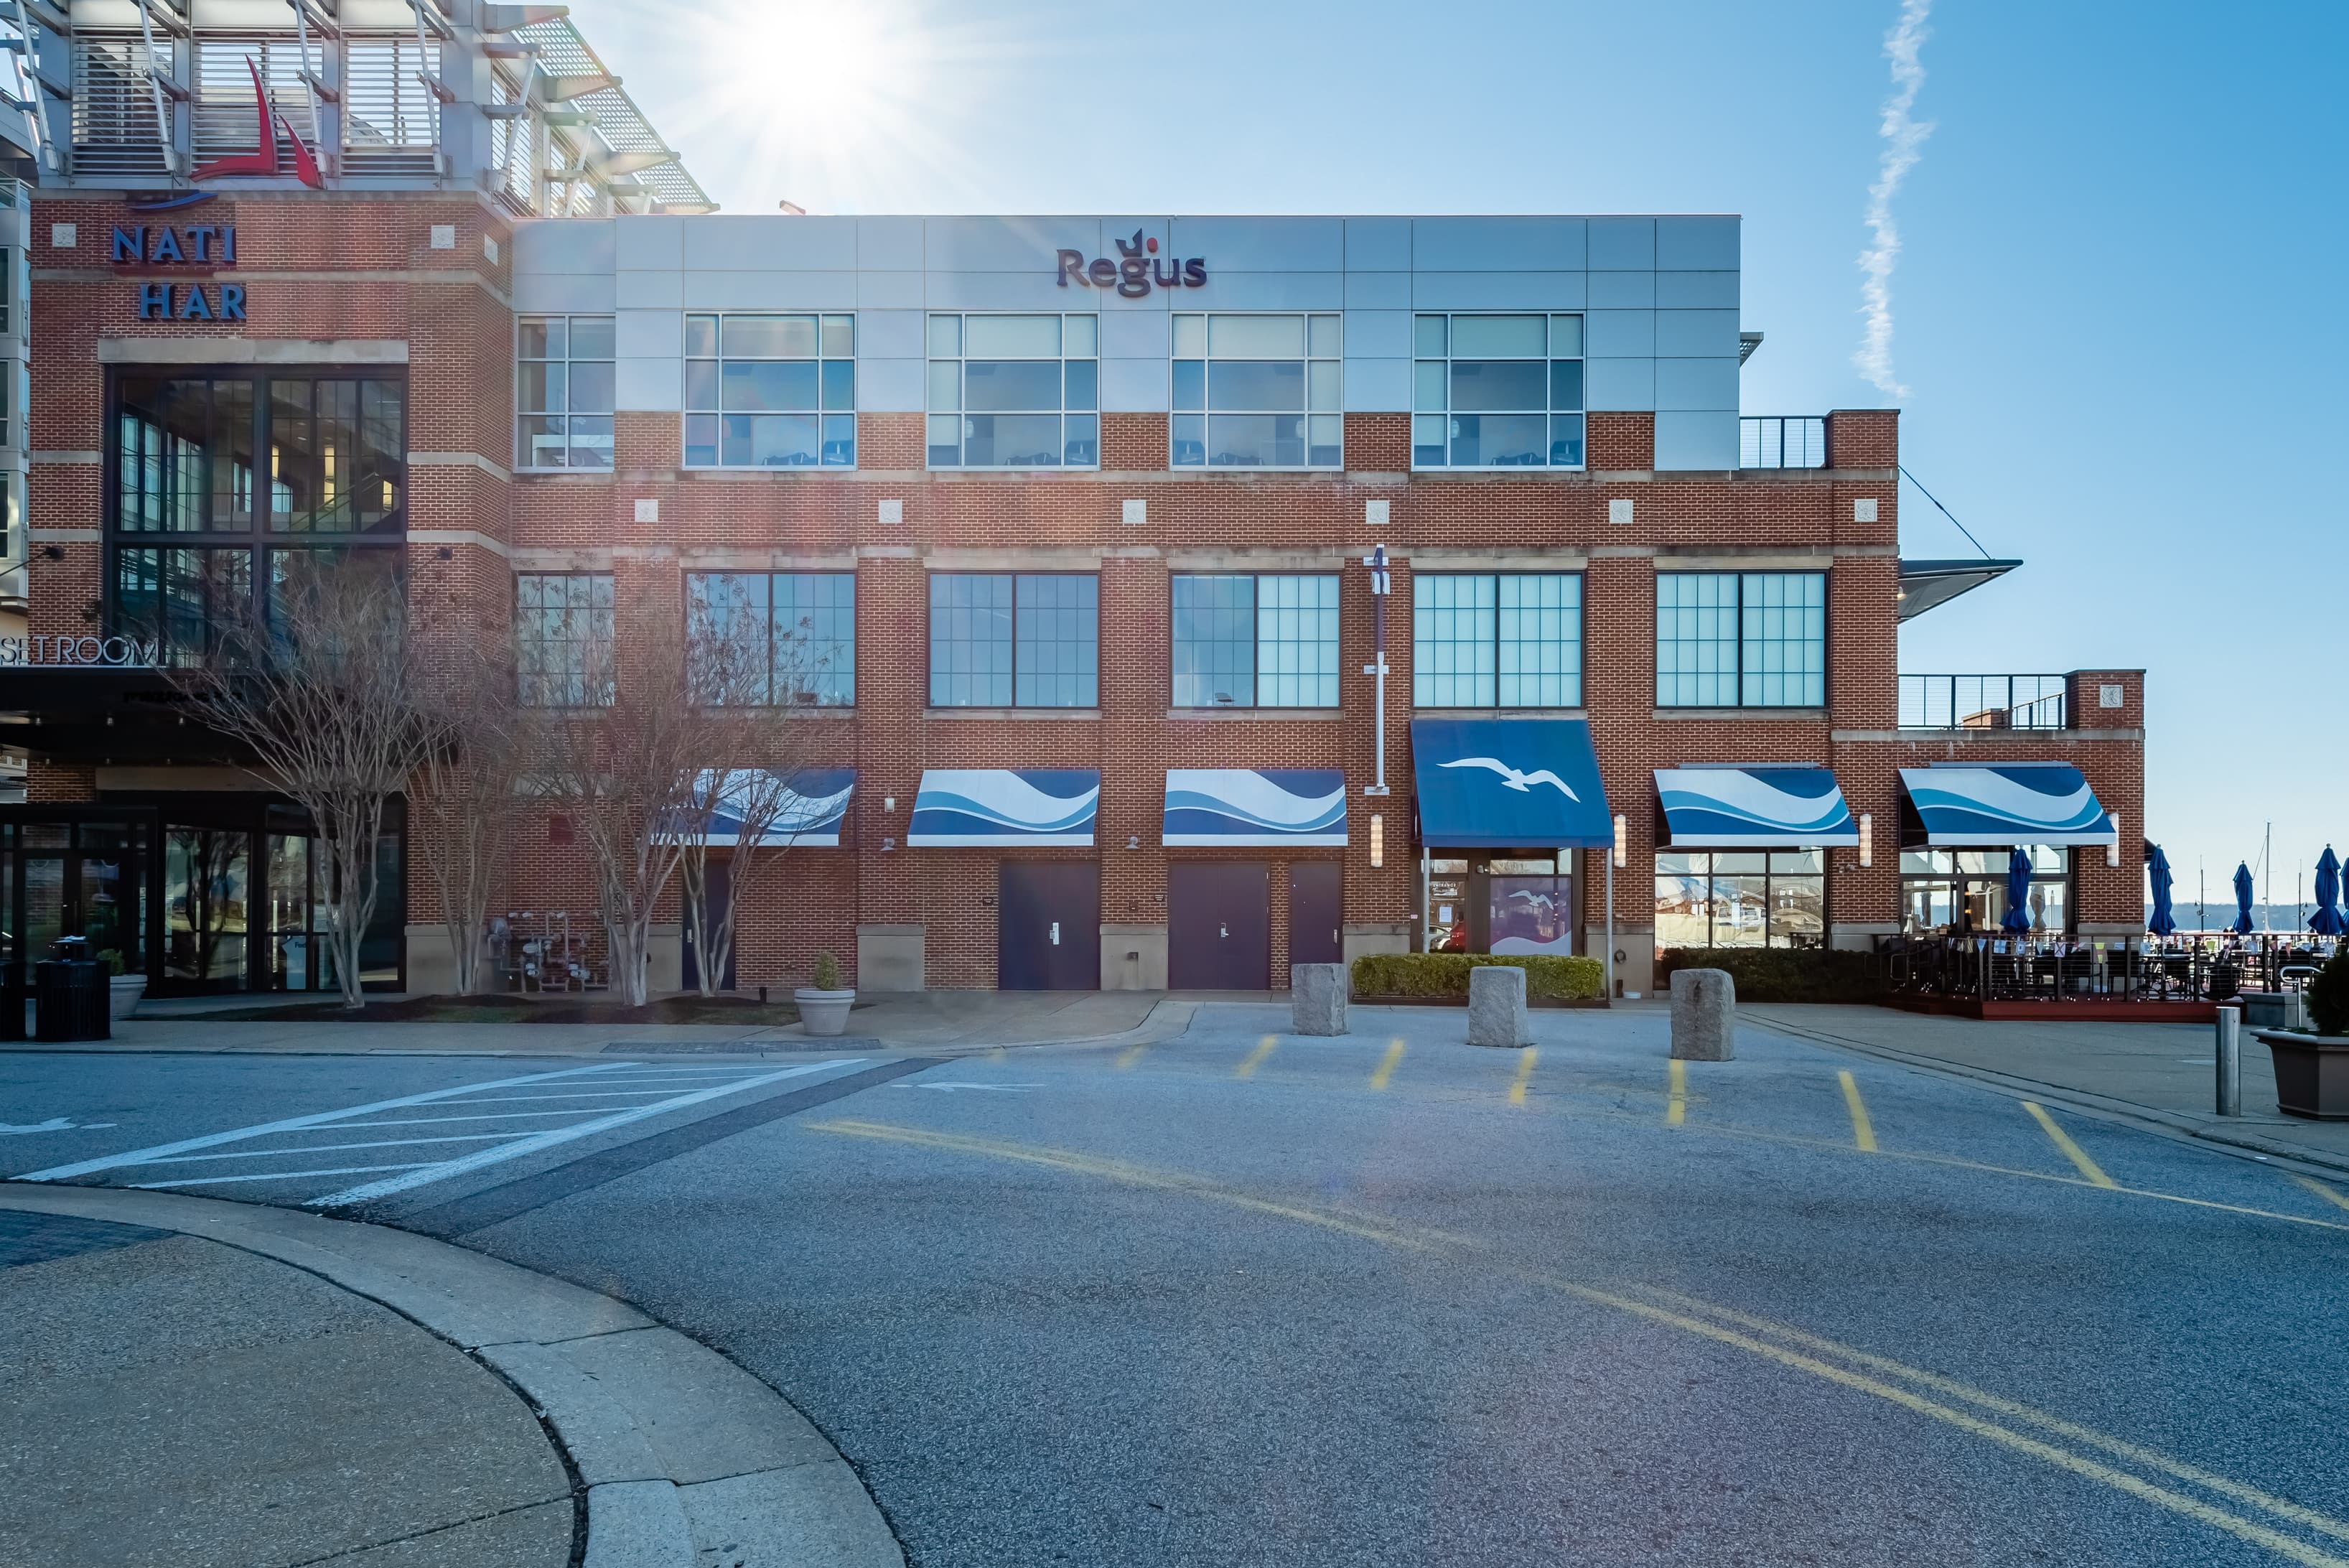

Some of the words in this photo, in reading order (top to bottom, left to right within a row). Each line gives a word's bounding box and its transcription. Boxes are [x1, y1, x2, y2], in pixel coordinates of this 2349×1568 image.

[111, 225, 235, 261] NATI
[1057, 248, 1208, 298] Regus
[139, 281, 246, 319] HAR
[0, 635, 50, 663] SET
[57, 635, 159, 663] ROOM
